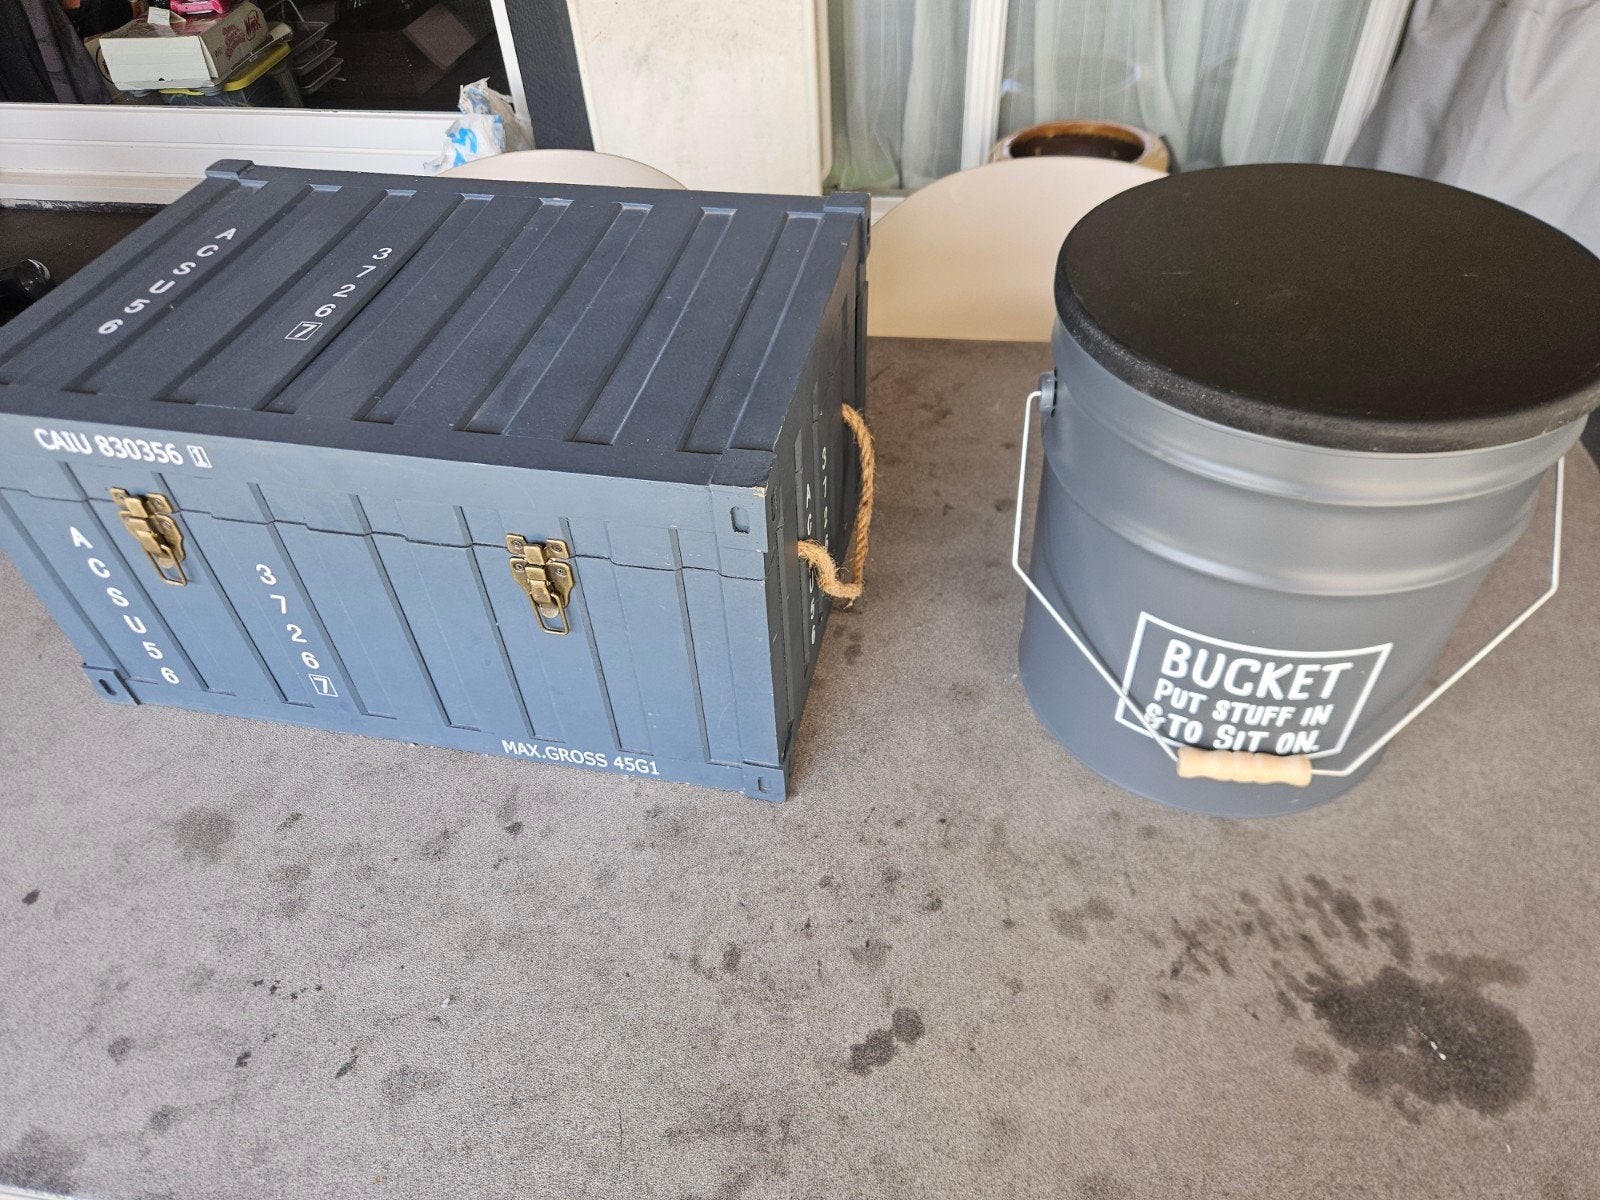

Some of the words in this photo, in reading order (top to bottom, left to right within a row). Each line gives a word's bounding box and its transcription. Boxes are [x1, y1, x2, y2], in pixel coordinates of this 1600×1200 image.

[98, 227, 237, 334] ACSU56
[33, 427, 93, 455] CAIU
[94, 434, 184, 465] 830356
[69, 526, 180, 685] ACSU56
[1160, 638, 1354, 701] BUCKET
[1154, 678, 1208, 714] PUT
[1211, 699, 1296, 728] STUFF
[1300, 703, 1335, 727] IN
[1212, 724, 1270, 752] SIT
[1274, 731, 1321, 754] ON.
[613, 756, 660, 776] 45G1
